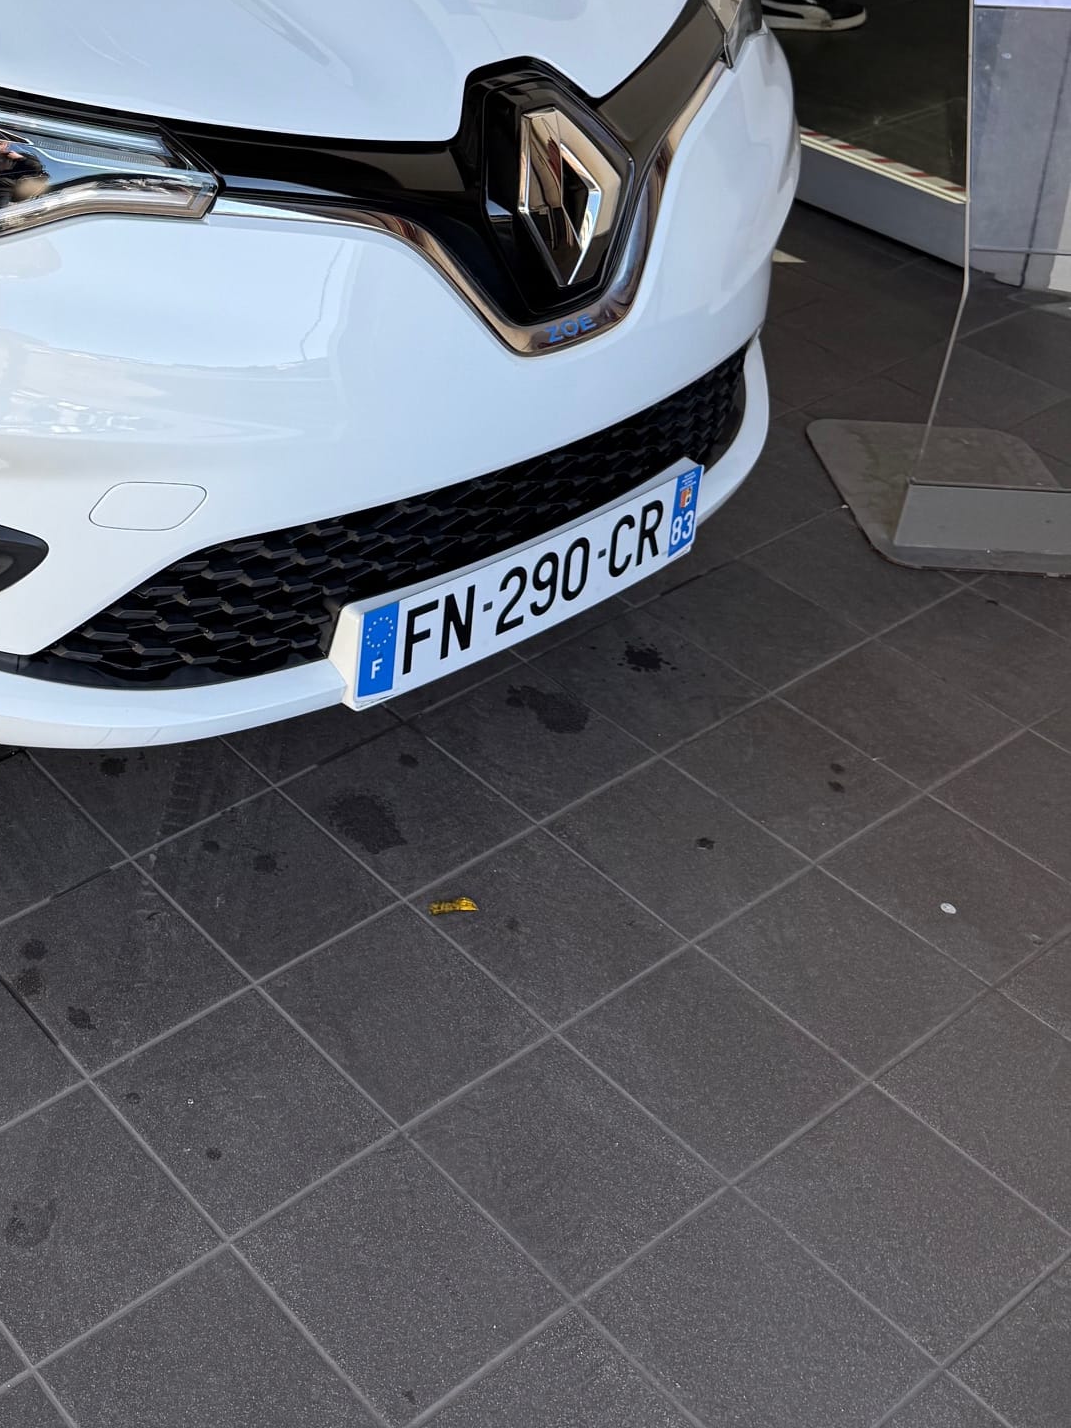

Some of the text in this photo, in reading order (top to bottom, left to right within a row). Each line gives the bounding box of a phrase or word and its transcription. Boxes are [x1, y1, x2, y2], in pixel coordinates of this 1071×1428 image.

[671, 510, 694, 546] 83
[402, 500, 664, 675] FN-290-CR
[371, 658, 383, 680] F
